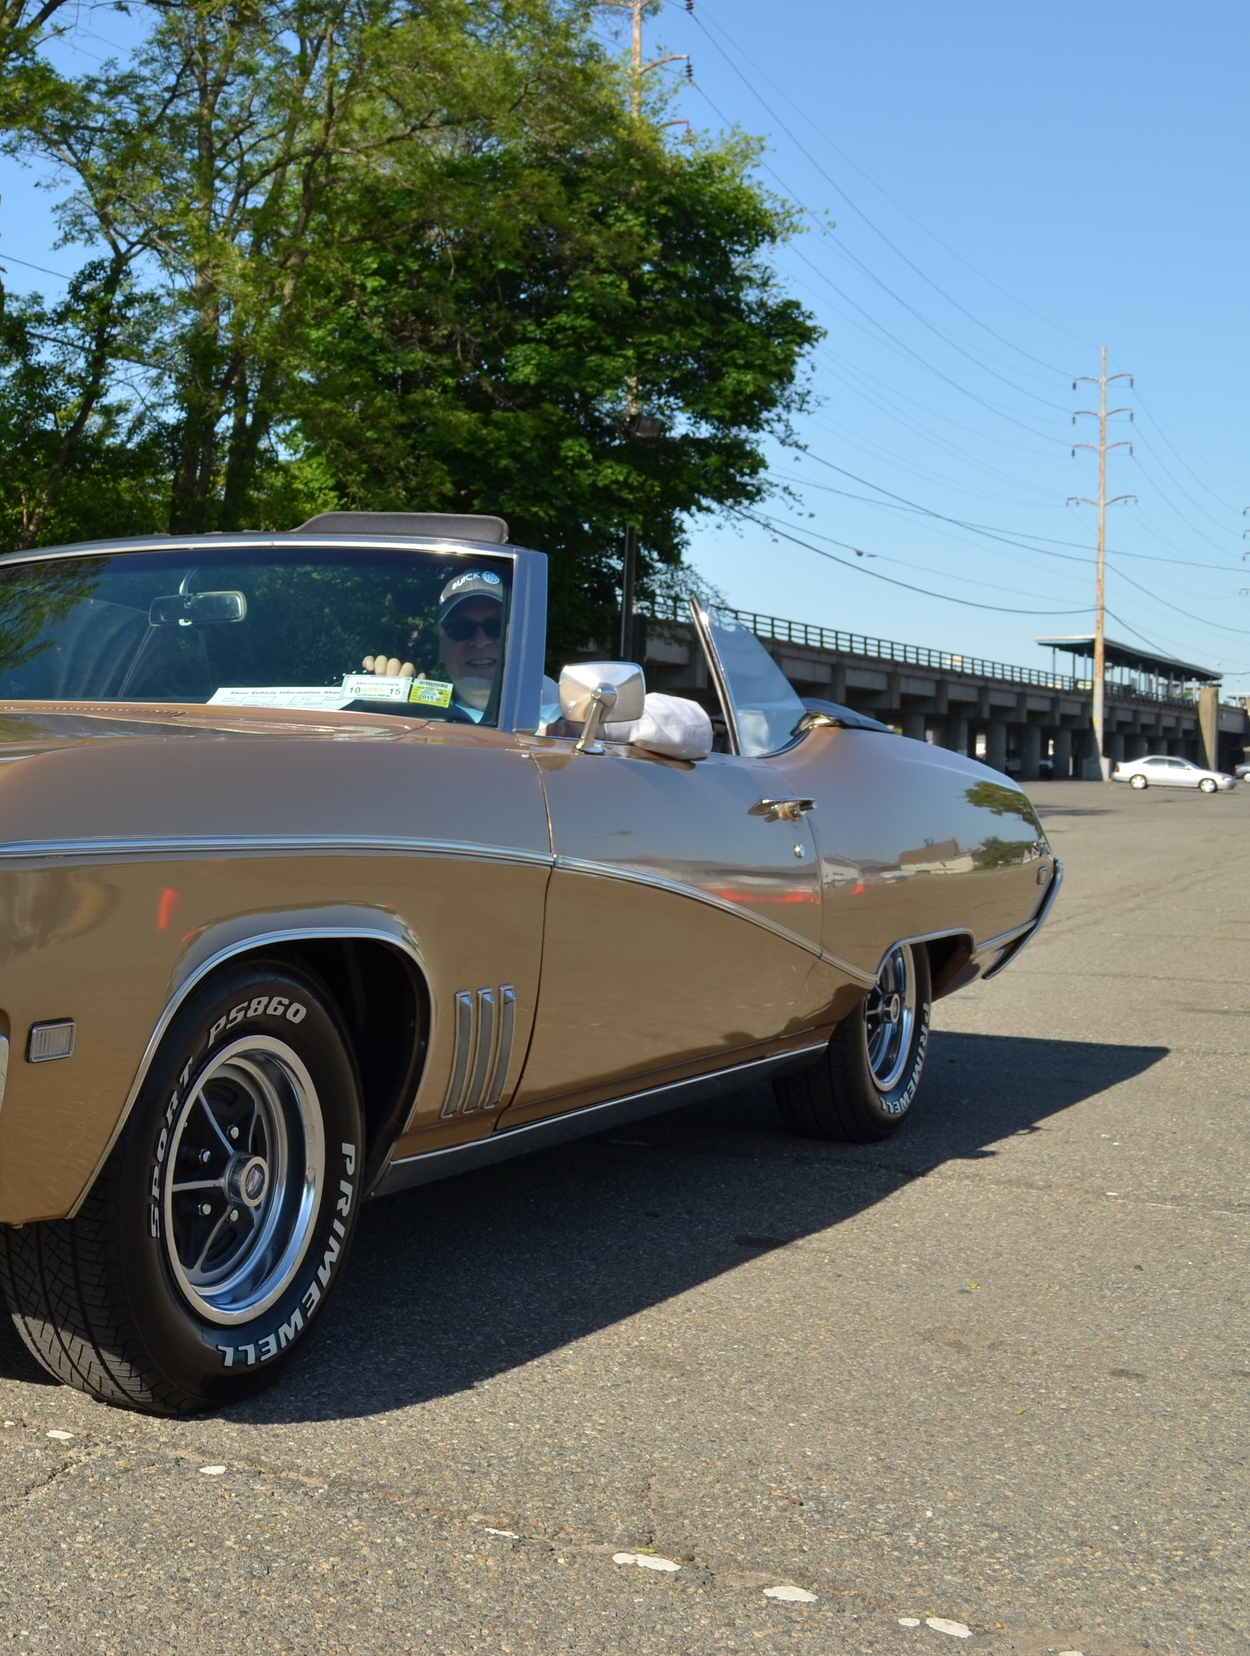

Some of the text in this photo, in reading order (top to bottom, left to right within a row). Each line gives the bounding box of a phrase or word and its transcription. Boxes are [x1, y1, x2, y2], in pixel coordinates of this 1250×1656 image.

[452, 572, 480, 590] BUICK
[150, 996, 307, 1238] SPORT PS860
[879, 1002, 930, 1114] PRIMEWELL
[217, 1142, 356, 1367] PRIMEWELL
